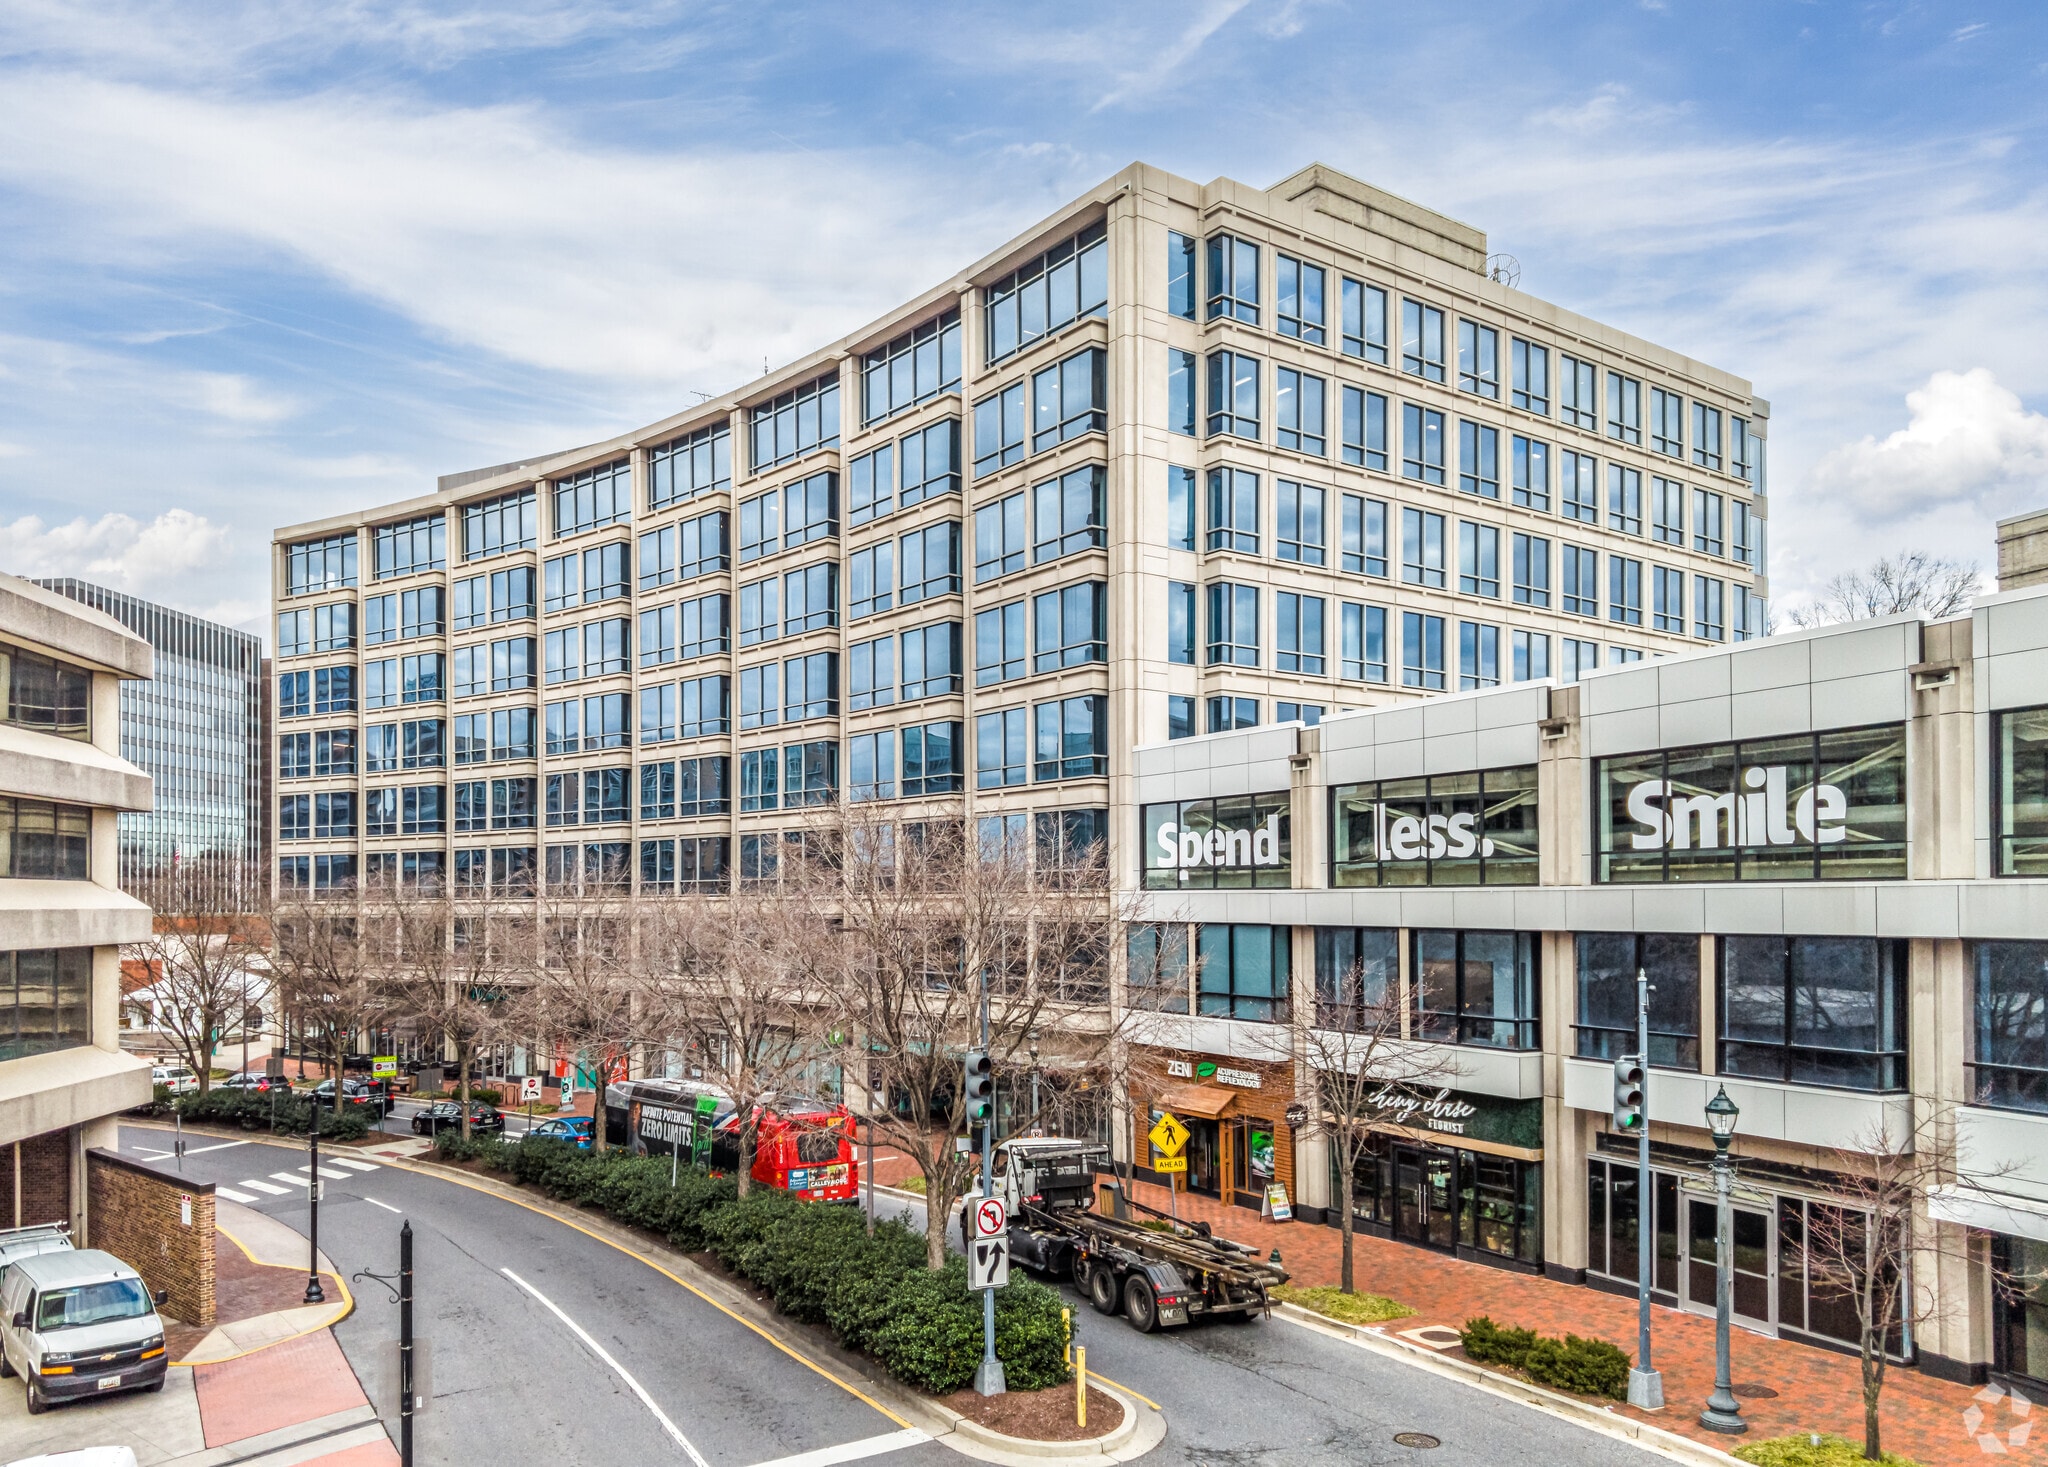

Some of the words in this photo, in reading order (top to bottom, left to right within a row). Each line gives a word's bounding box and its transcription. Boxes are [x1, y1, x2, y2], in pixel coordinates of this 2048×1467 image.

[1157, 814, 1279, 880] Spend
[1374, 803, 1495, 860] less.
[1628, 766, 1847, 849] Smile
[1167, 1060, 1193, 1078] ZEN
[1217, 1067, 1262, 1081] ACUPRESSURE
[1216, 1075, 1262, 1089] REFLEXOLOGY
[641, 1105, 663, 1120] INFINITE
[663, 1108, 694, 1126] POTENTIAL.
[641, 1118, 663, 1140] ZERO
[663, 1122, 693, 1147] LIMITS.
[1428, 1118, 1464, 1134] FLORIST
[1160, 1161, 1183, 1169] AHEAD
